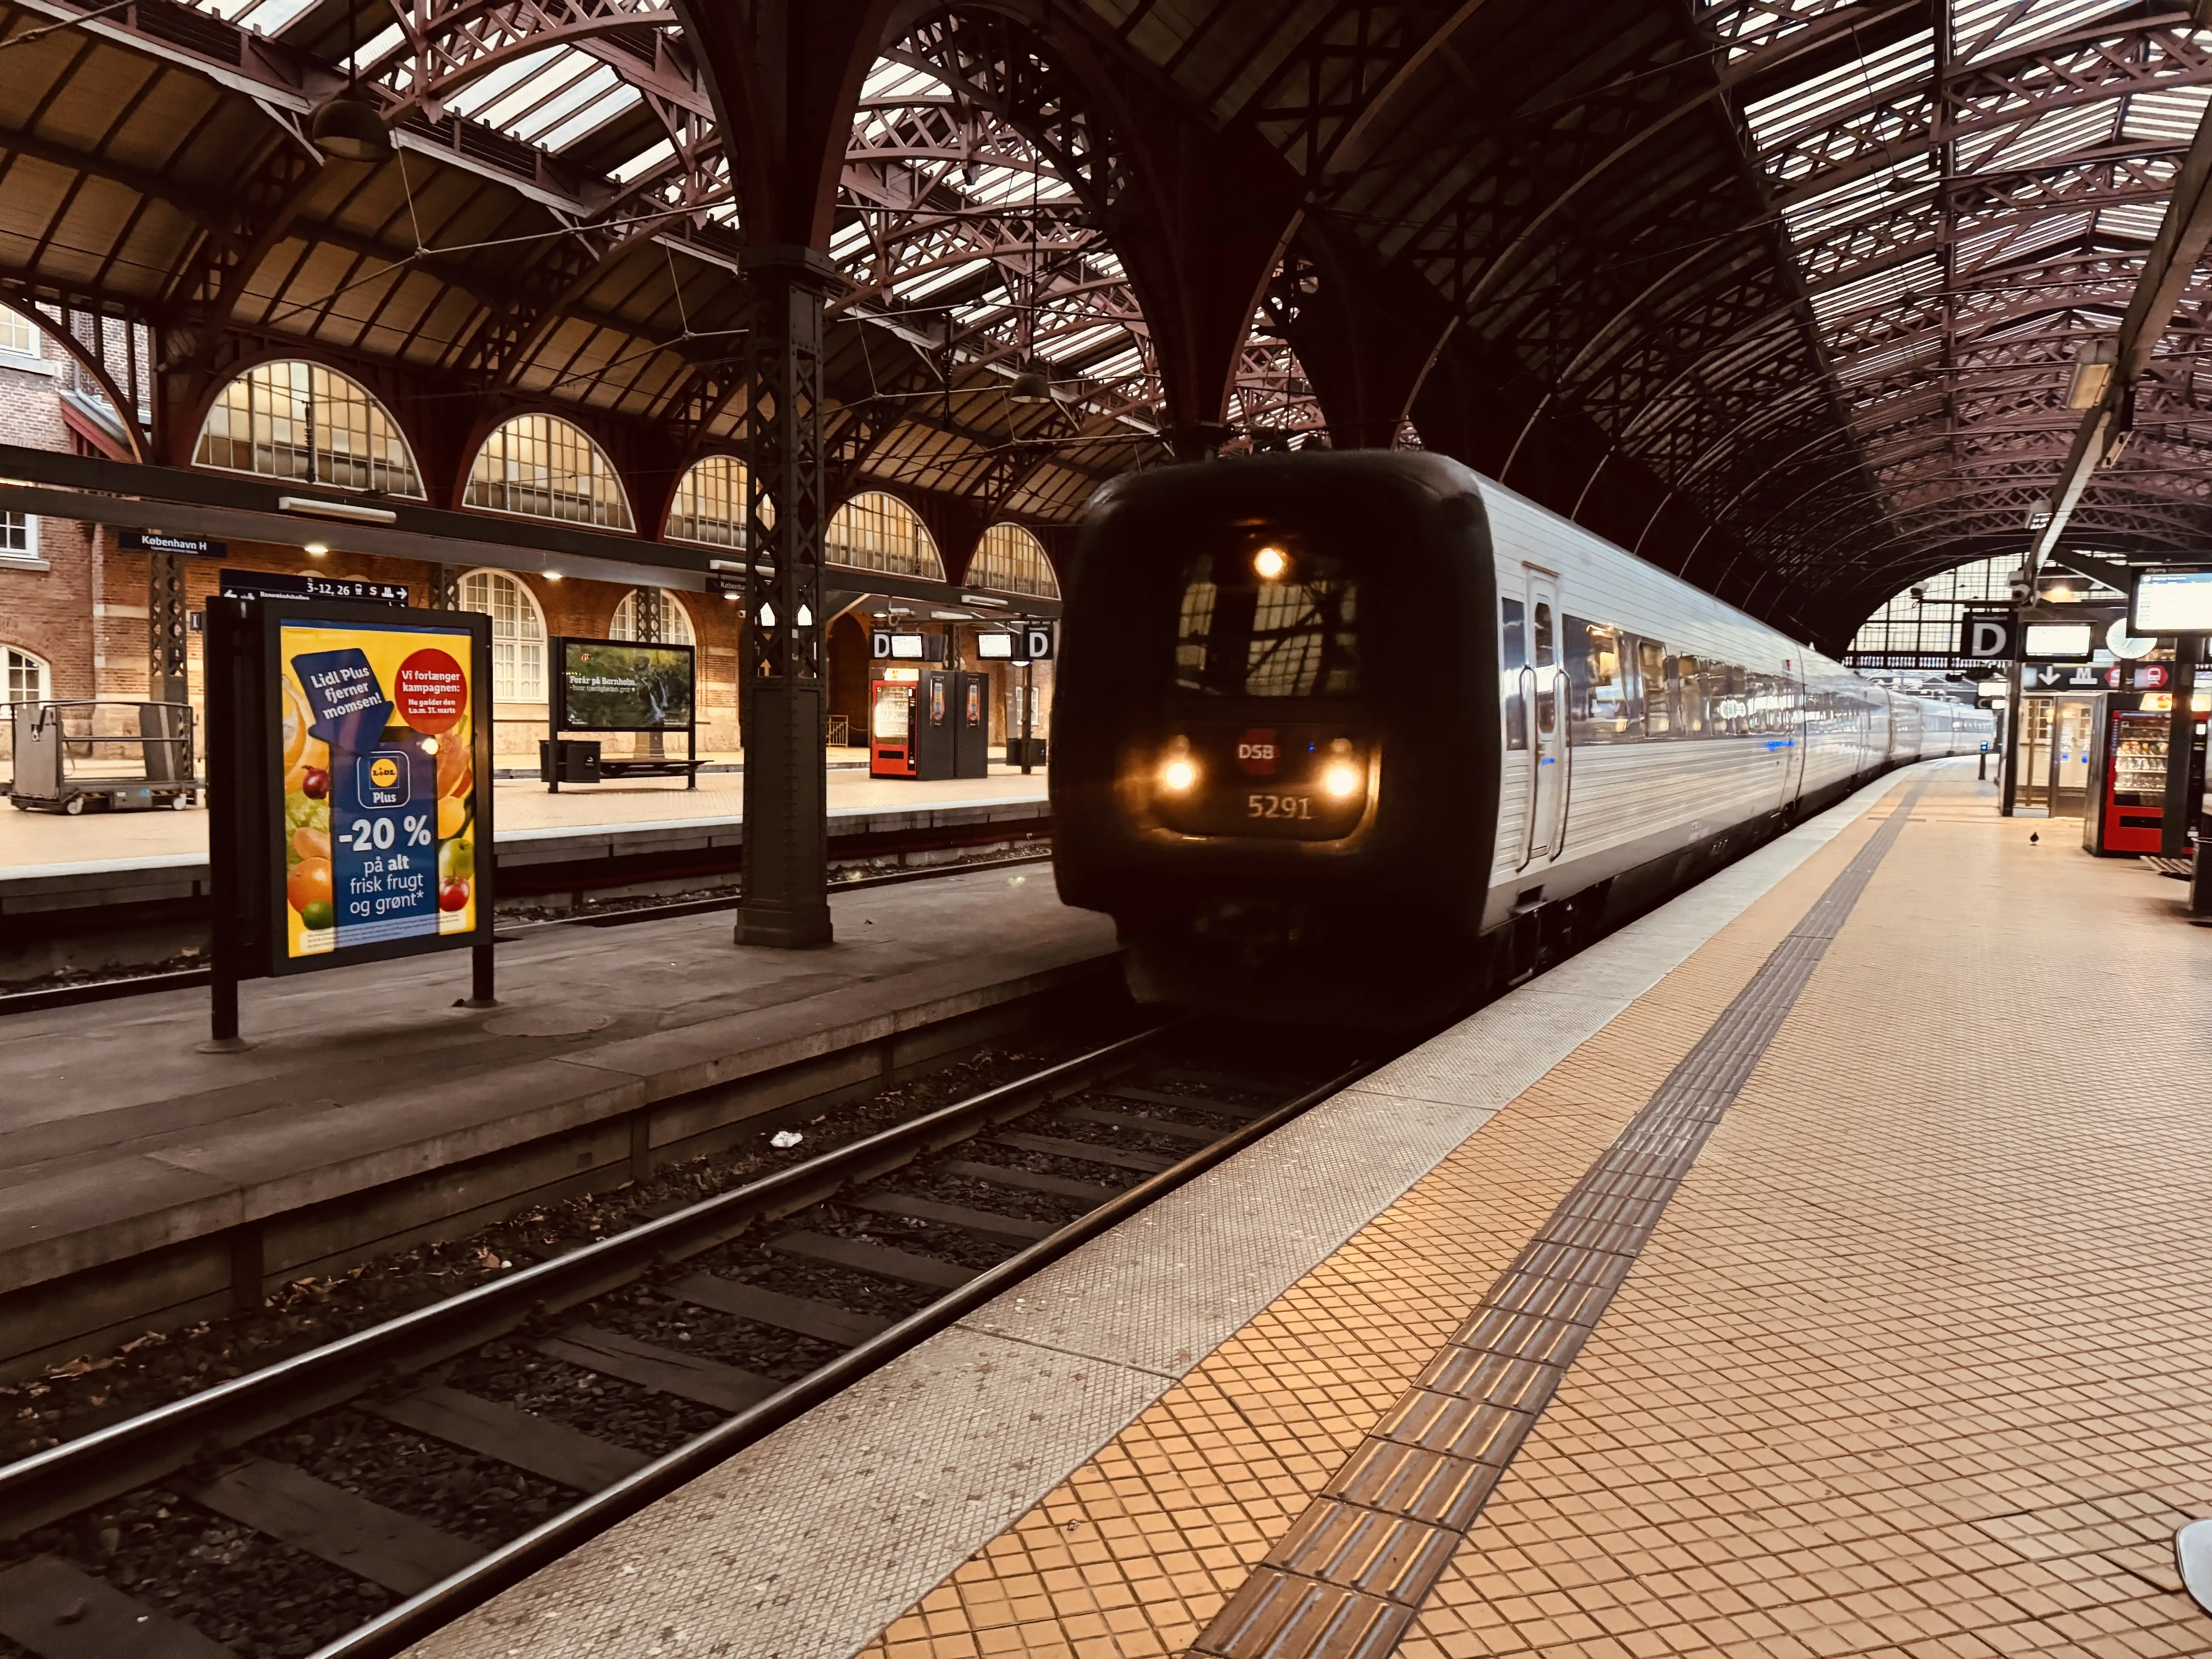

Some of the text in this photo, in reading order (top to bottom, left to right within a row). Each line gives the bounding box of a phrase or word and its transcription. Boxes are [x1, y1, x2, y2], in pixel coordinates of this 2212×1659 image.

[142, 536, 197, 550] København
[199, 542, 207, 551] H
[307, 582, 334, 596] 3-12,
[337, 586, 350, 596] 26
[721, 581, 746, 591] Københa
[874, 634, 890, 658] D
[1029, 632, 1048, 657] D
[1972, 623, 2006, 656] D
[310, 667, 370, 688] Lidl Plus
[402, 670, 460, 683] Vi forlænger
[569, 675, 635, 686] Forår på Bornholm
[325, 682, 369, 704] fjerner
[402, 682, 460, 694] kampagnen:
[322, 692, 382, 719] momsen!
[1239, 744, 1274, 759] DSB
[373, 791, 397, 804] Plus
[1248, 795, 1310, 819] 5291
[339, 815, 431, 851] -20 %
[364, 854, 409, 878] på alt
[350, 873, 424, 895] frisk frugt
[350, 900, 370, 917] og
